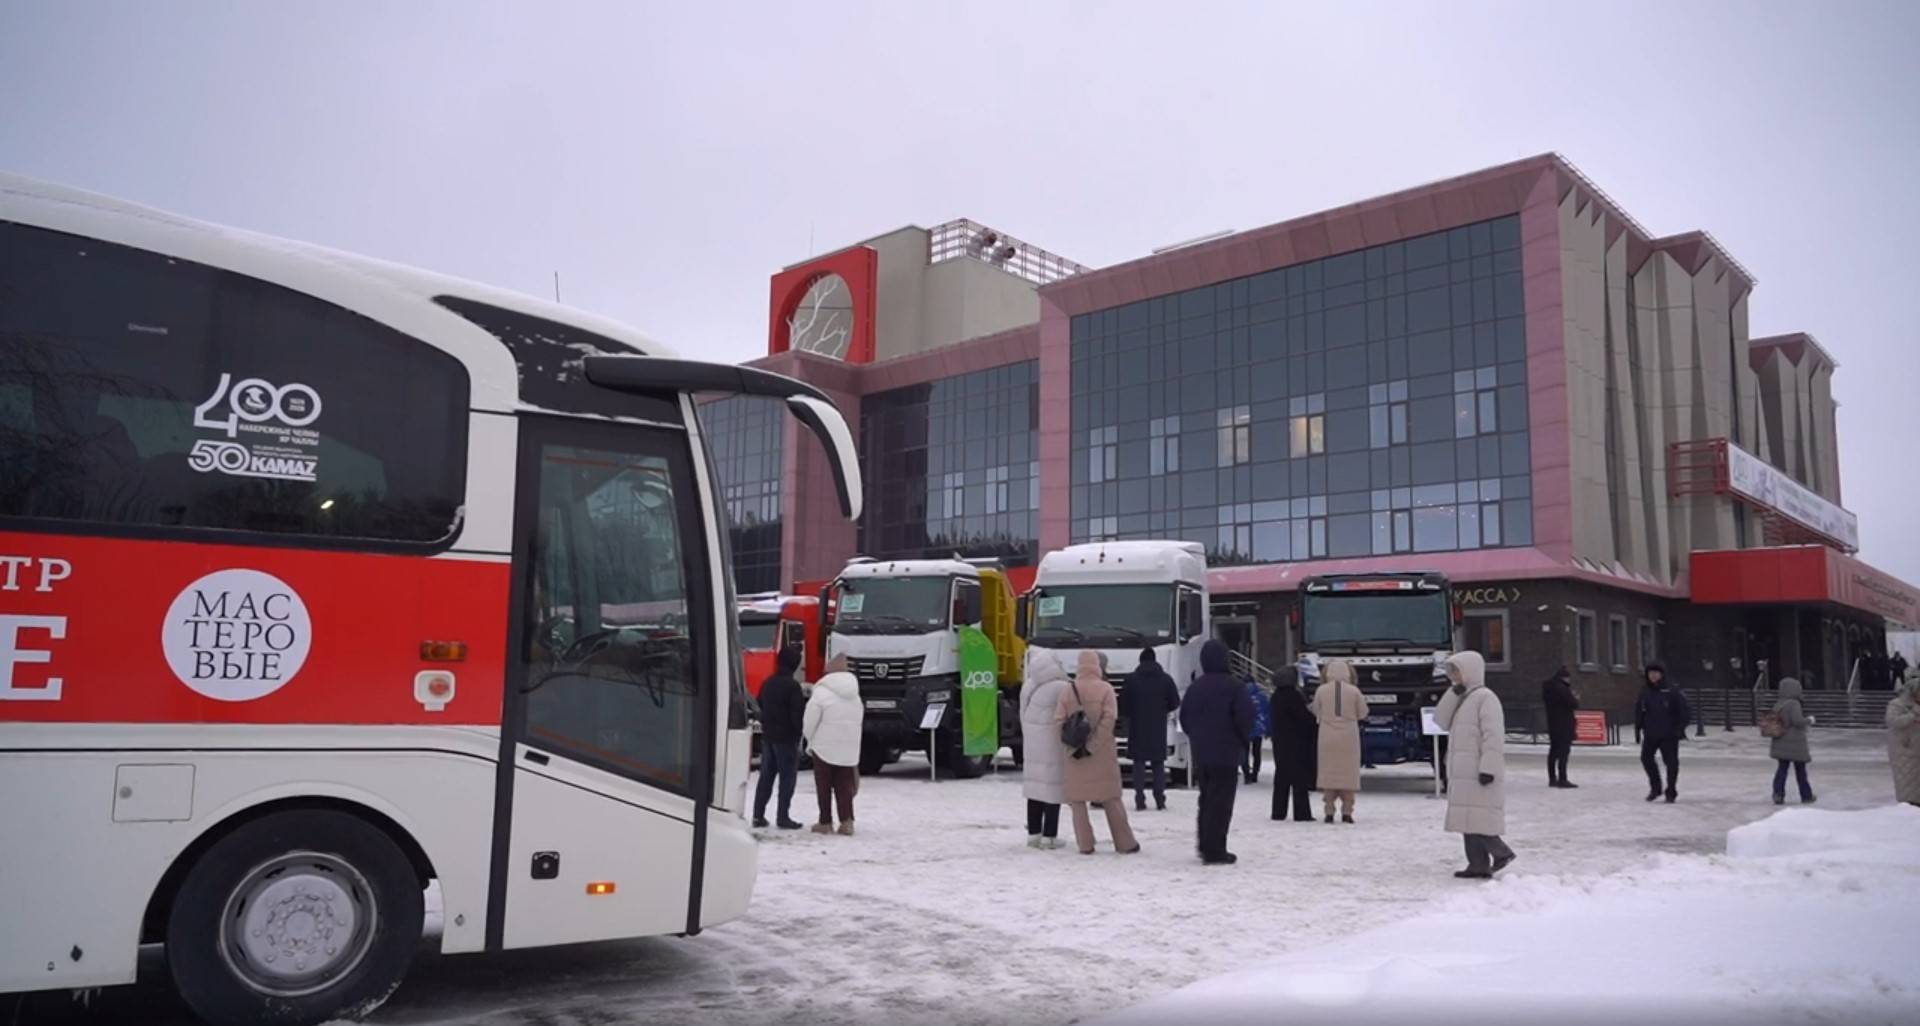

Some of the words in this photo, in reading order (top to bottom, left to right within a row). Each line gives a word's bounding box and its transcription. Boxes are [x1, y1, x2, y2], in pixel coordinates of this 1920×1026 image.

[194, 372, 321, 438] 400
[188, 440, 250, 474] 50
[251, 456, 317, 477] KAMAZ
[191, 590, 292, 621] МАС
[1454, 587, 1508, 605] КАССА
[184, 619, 295, 651] ТЕРО
[191, 651, 283, 681] ВЫЕ
